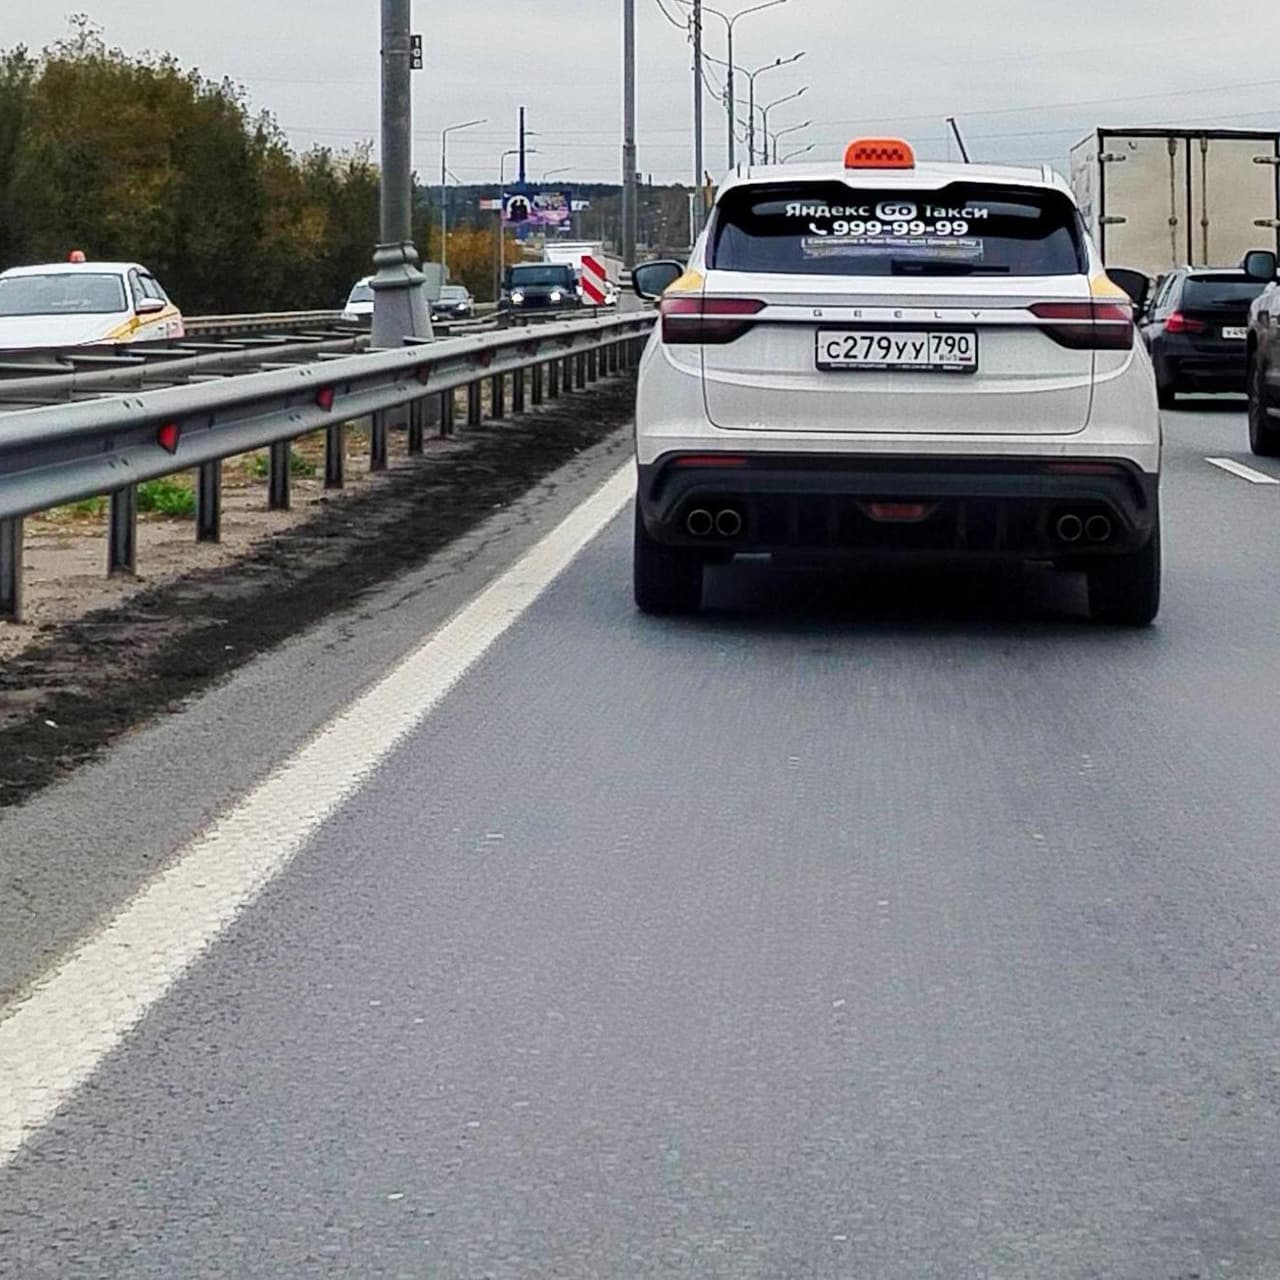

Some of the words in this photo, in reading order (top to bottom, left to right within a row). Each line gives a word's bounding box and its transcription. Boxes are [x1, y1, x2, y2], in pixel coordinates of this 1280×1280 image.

[784, 202, 870, 219] Яндекс
[925, 204, 990, 220] Такси
[832, 219, 969, 236] 999-99-99
